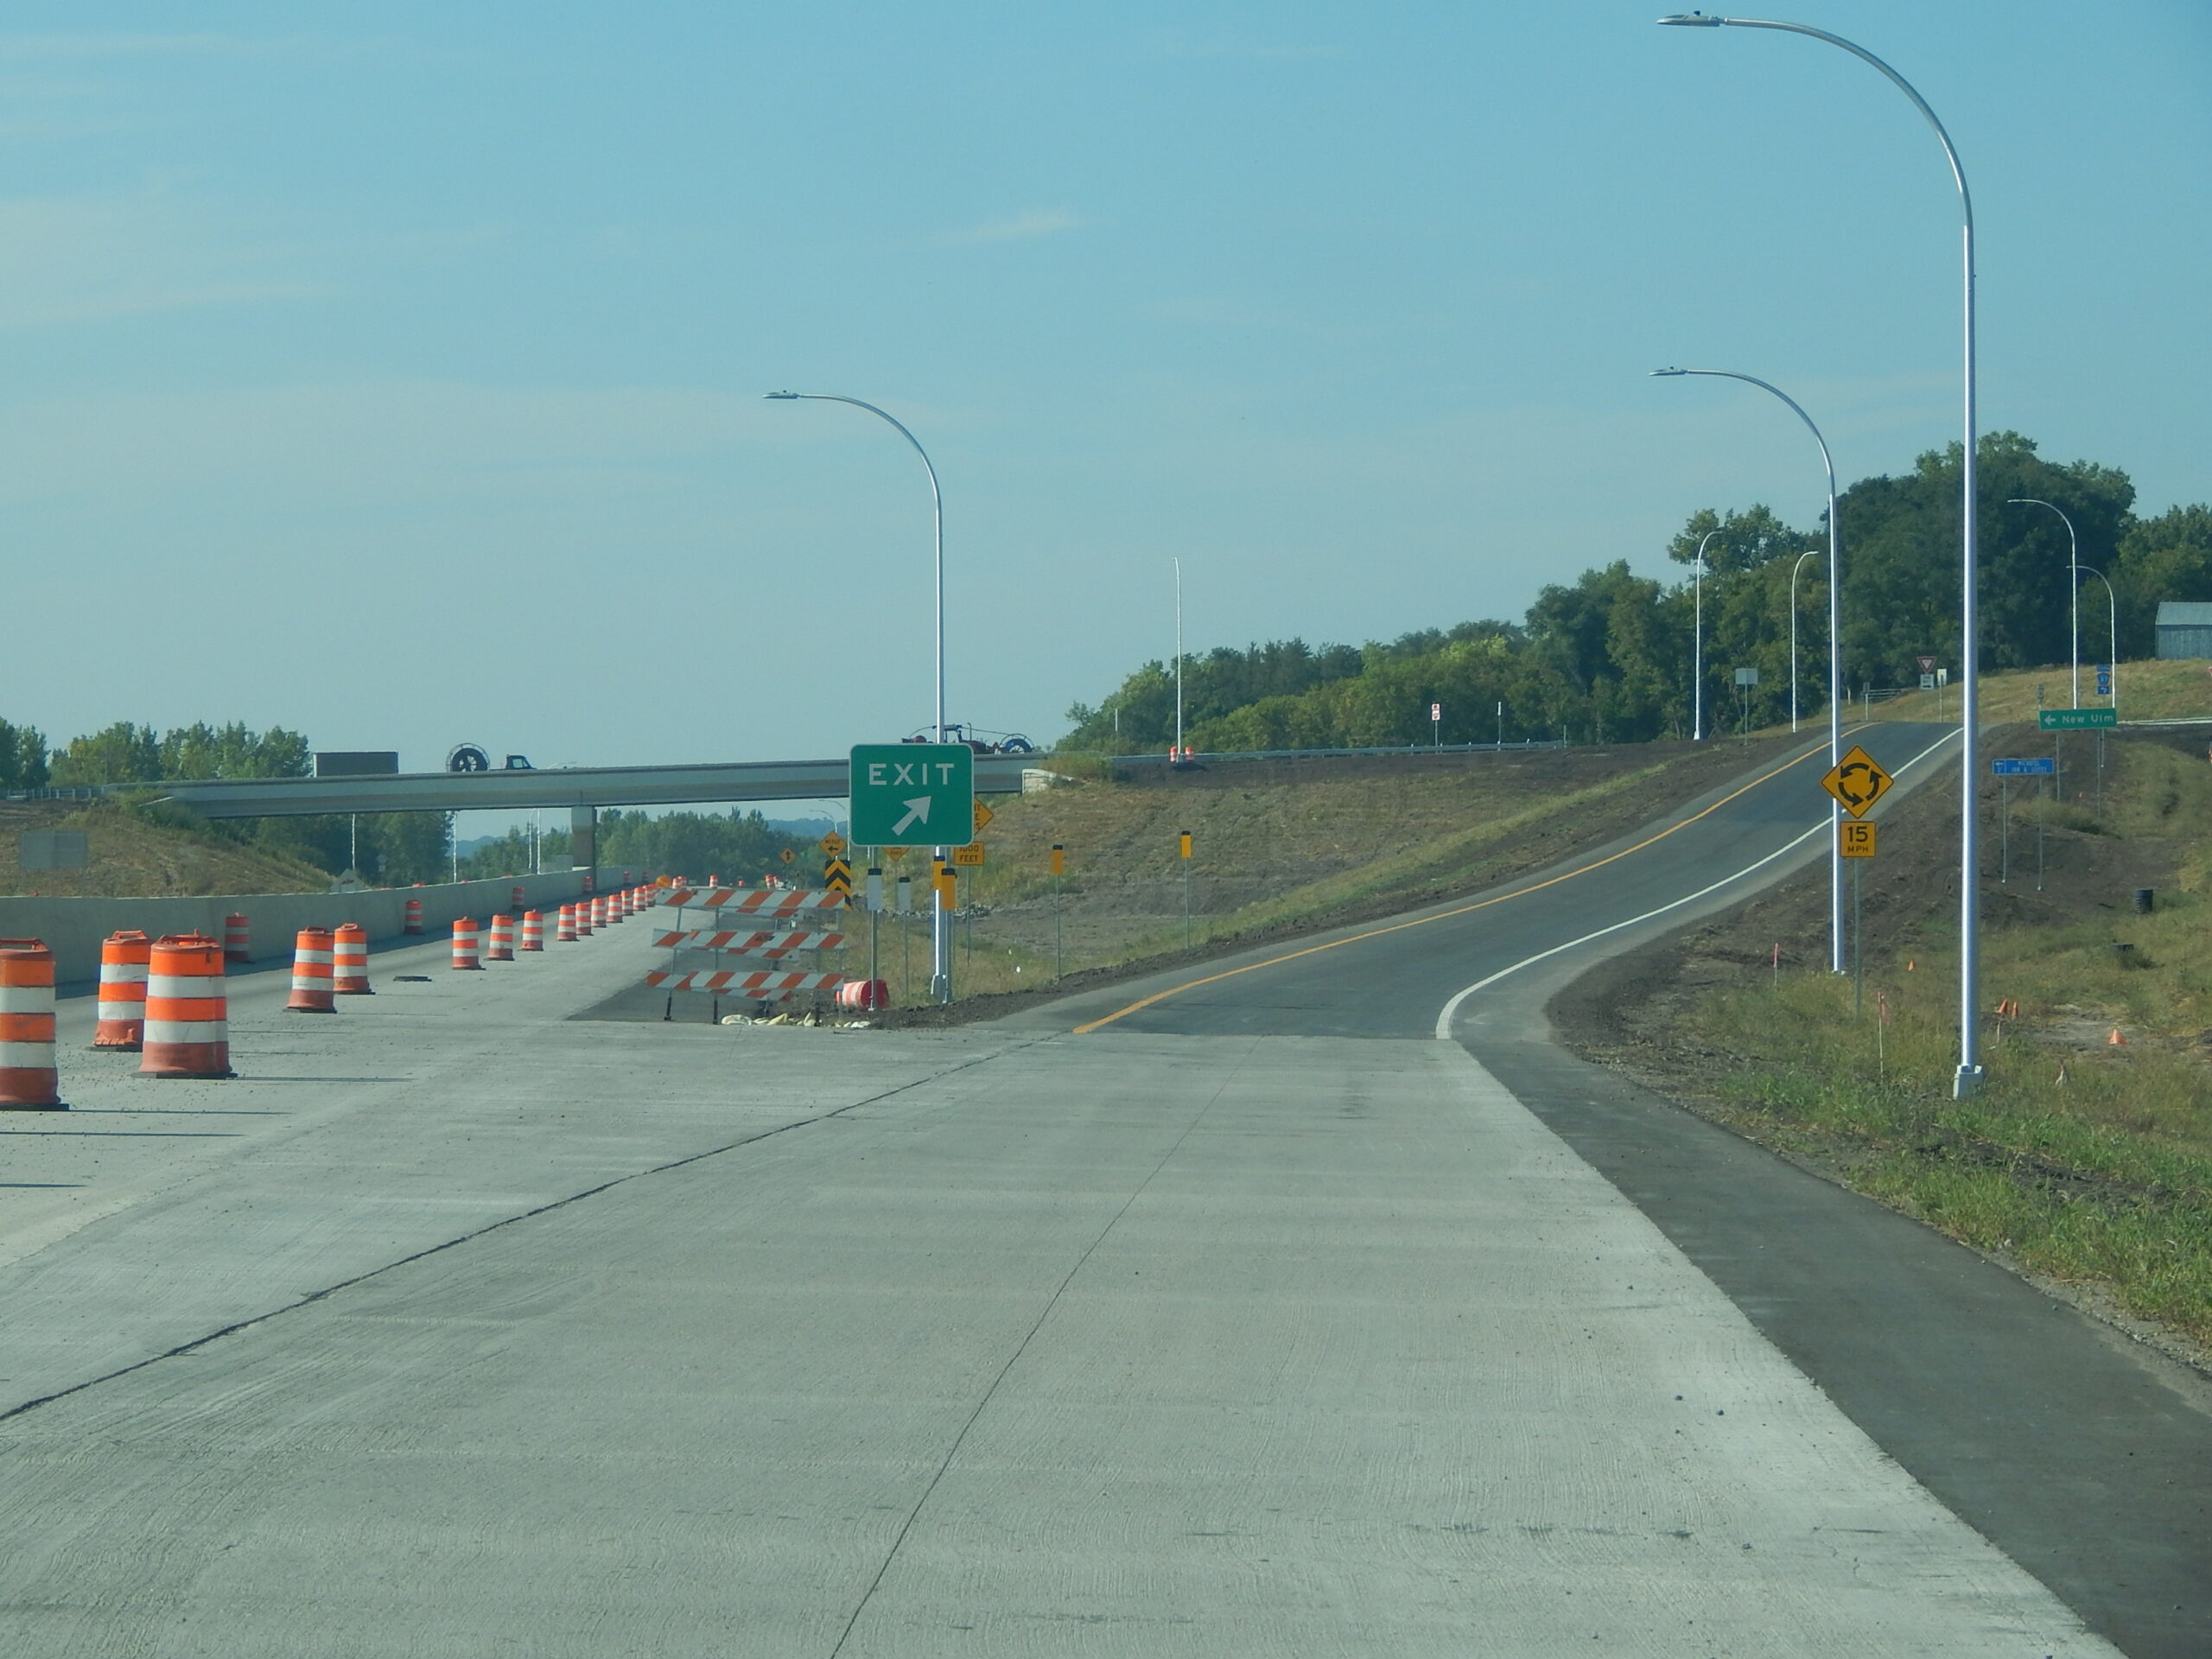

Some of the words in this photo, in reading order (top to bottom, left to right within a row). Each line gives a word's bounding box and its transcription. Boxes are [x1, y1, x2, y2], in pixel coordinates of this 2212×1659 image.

[2062, 715, 2085, 724] New
[2091, 714, 2113, 723] Ulm
[868, 763, 955, 785] EXIT
[1847, 826, 1868, 842] 15
